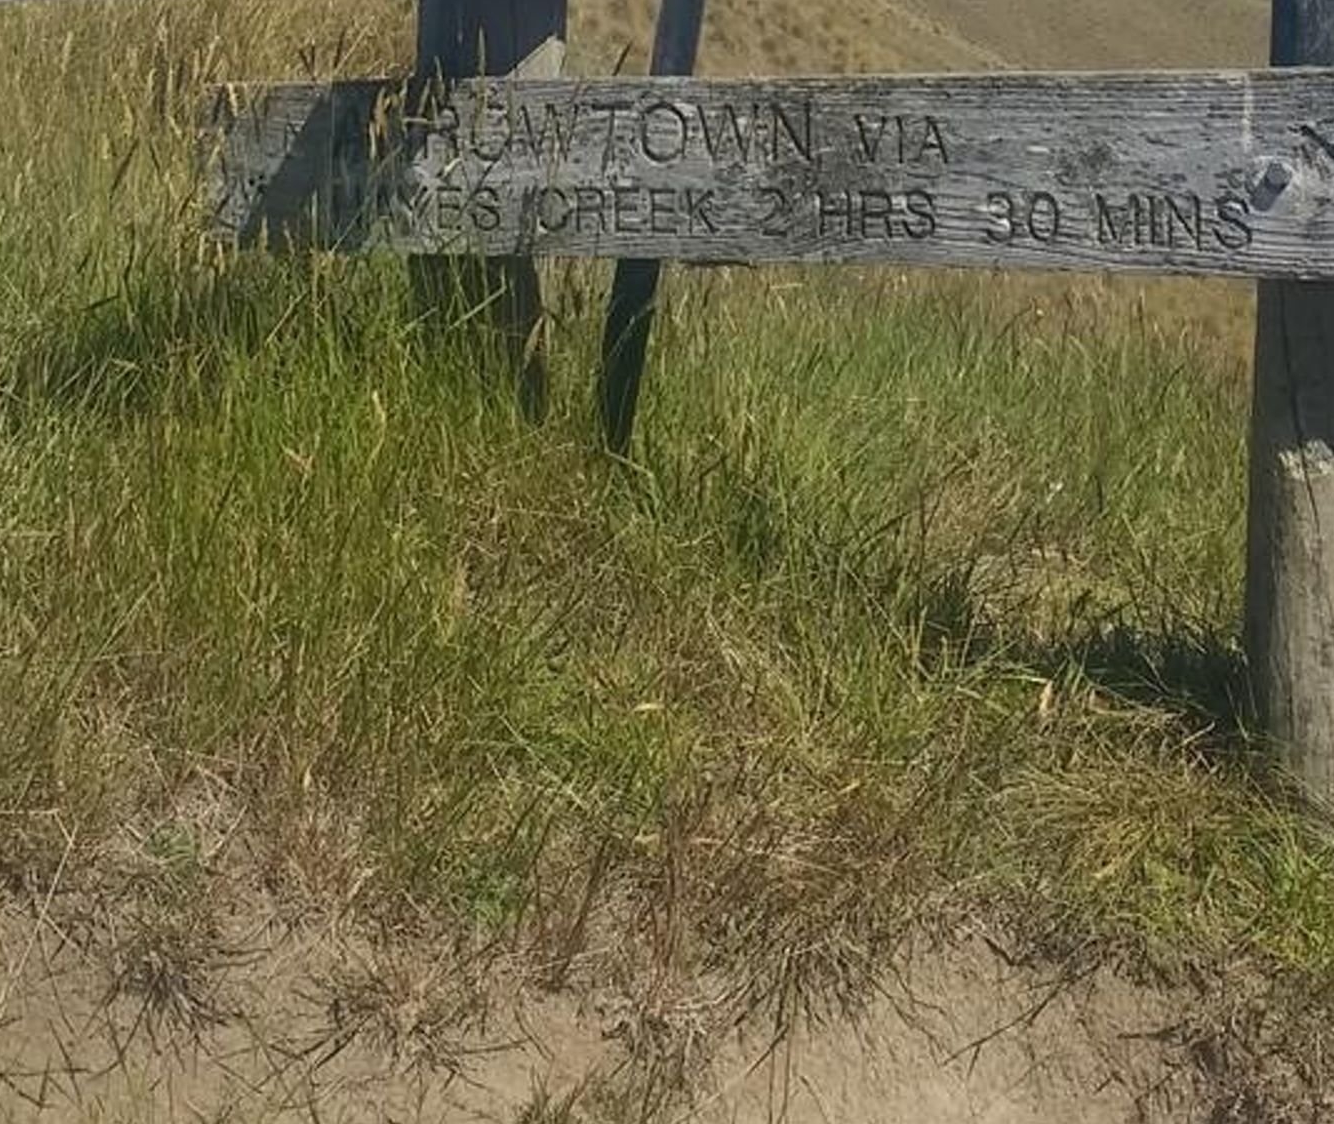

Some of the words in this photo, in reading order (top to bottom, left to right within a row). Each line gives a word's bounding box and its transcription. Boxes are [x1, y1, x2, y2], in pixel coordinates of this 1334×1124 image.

[853, 112, 950, 167] VIA
[535, 185, 720, 235] CREEK
[757, 187, 788, 237] 2
[816, 187, 939, 240] HRS
[986, 191, 1061, 244] 30
[1096, 193, 1253, 250] MINS
